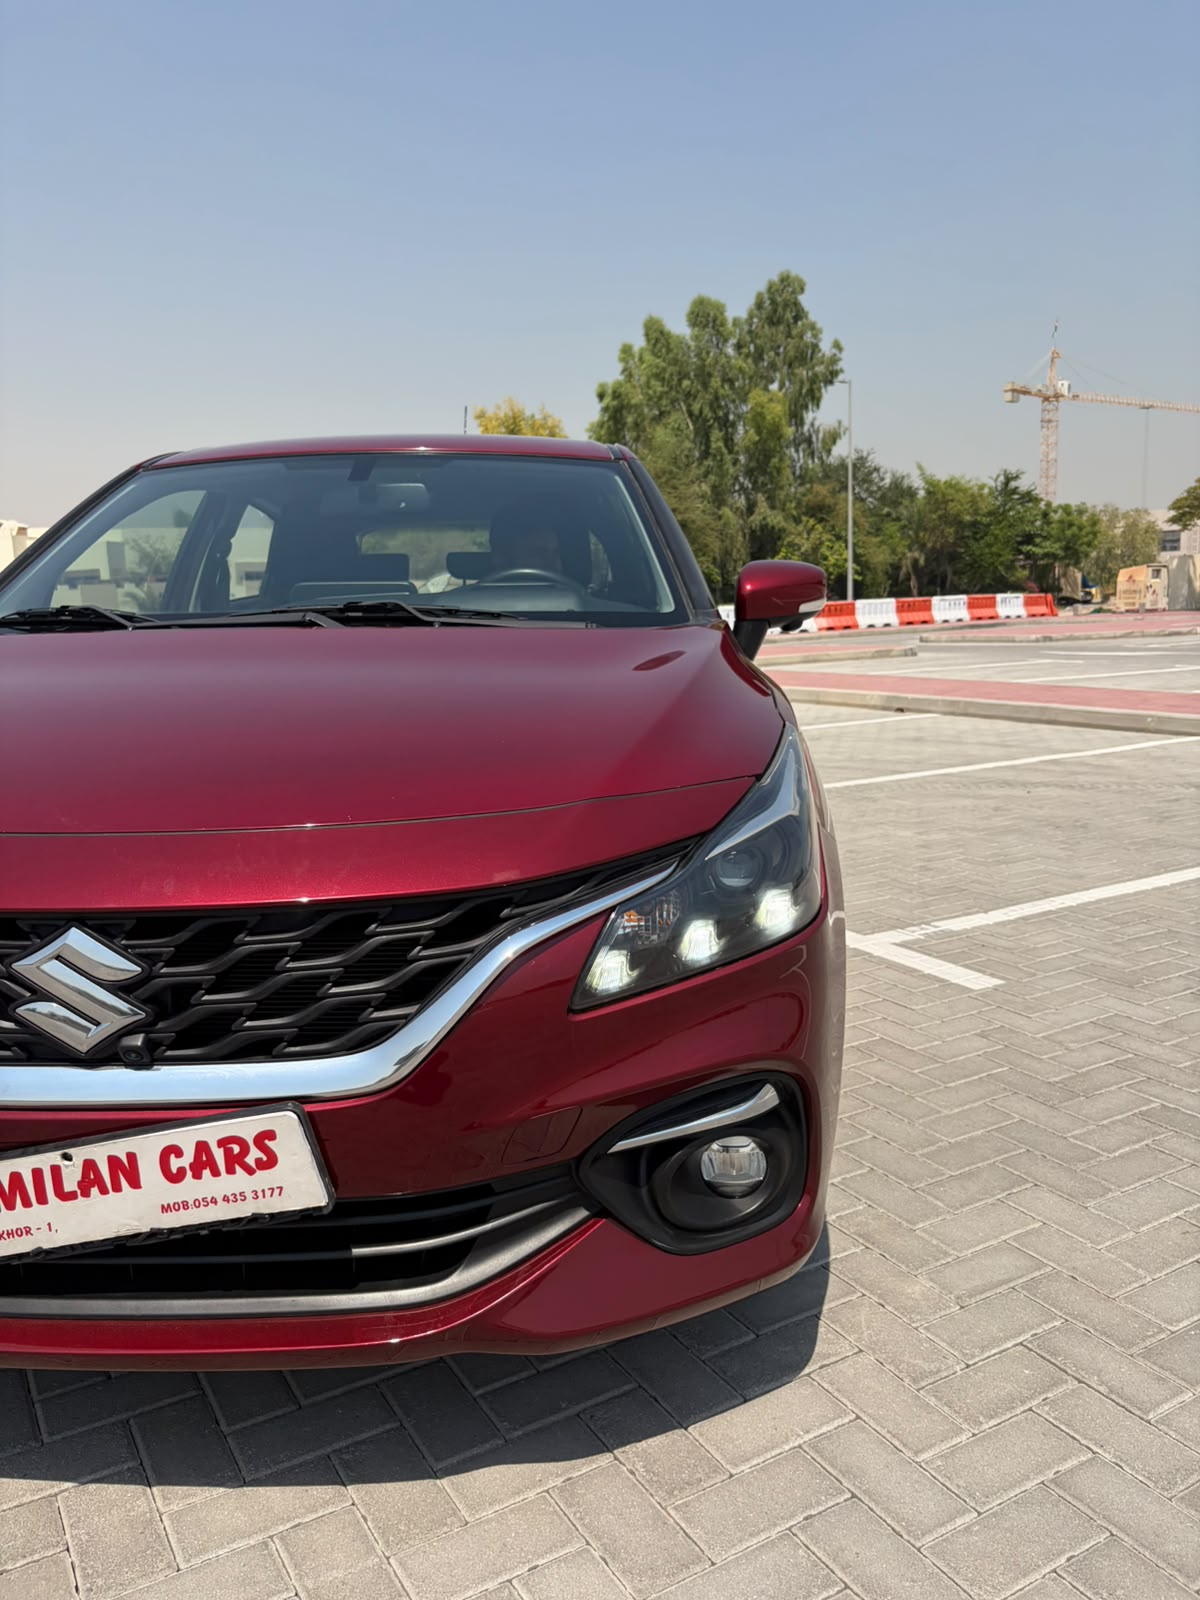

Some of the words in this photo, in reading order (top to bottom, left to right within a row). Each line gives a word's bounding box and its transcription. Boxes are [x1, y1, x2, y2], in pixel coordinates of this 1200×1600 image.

[0, 1151, 142, 1212] MILAN
[158, 1129, 279, 1185] CARS
[160, 1196, 218, 1214] MOB:054
[221, 1191, 247, 1204] 435
[251, 1186, 284, 1200] 3177
